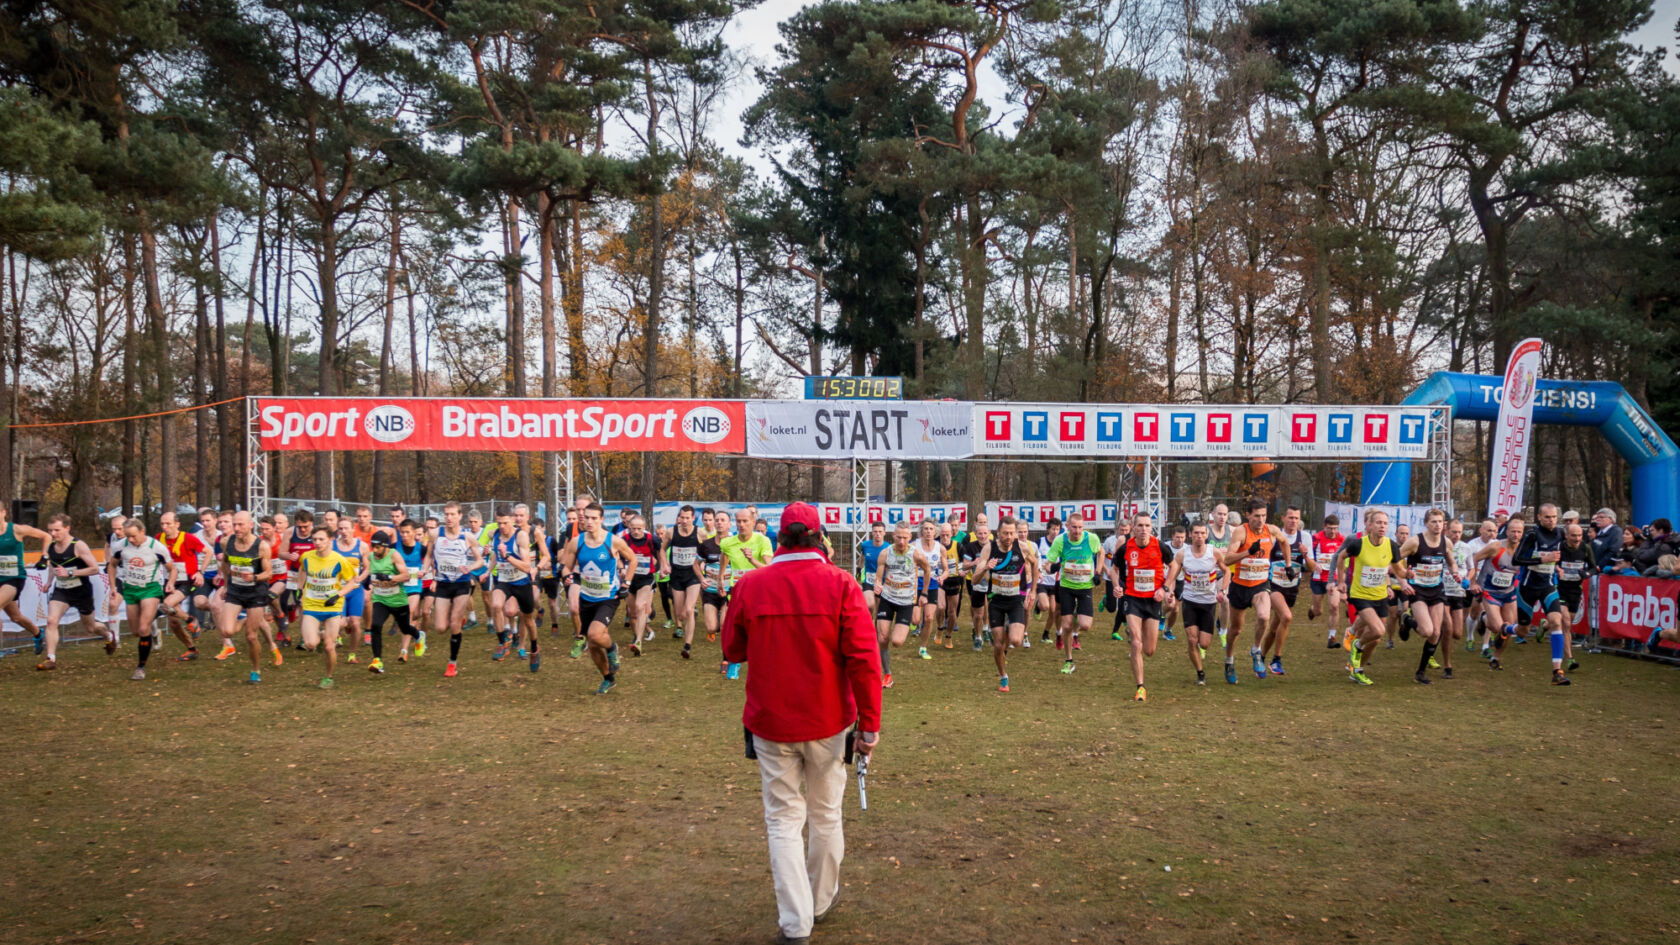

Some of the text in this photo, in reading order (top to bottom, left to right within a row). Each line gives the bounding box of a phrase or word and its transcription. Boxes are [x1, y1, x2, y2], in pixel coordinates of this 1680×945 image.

[261, 405, 720, 445] Sport NB BrabantSport NB
[769, 425, 807, 435] loket.nl
[815, 409, 909, 450] START
[931, 426, 968, 437] loket.nl
[989, 416, 1265, 437] T T T T T T T T
[1295, 418, 1421, 438] T T T T
[128, 571, 146, 580] 3526
[1607, 583, 1677, 629] Braba
